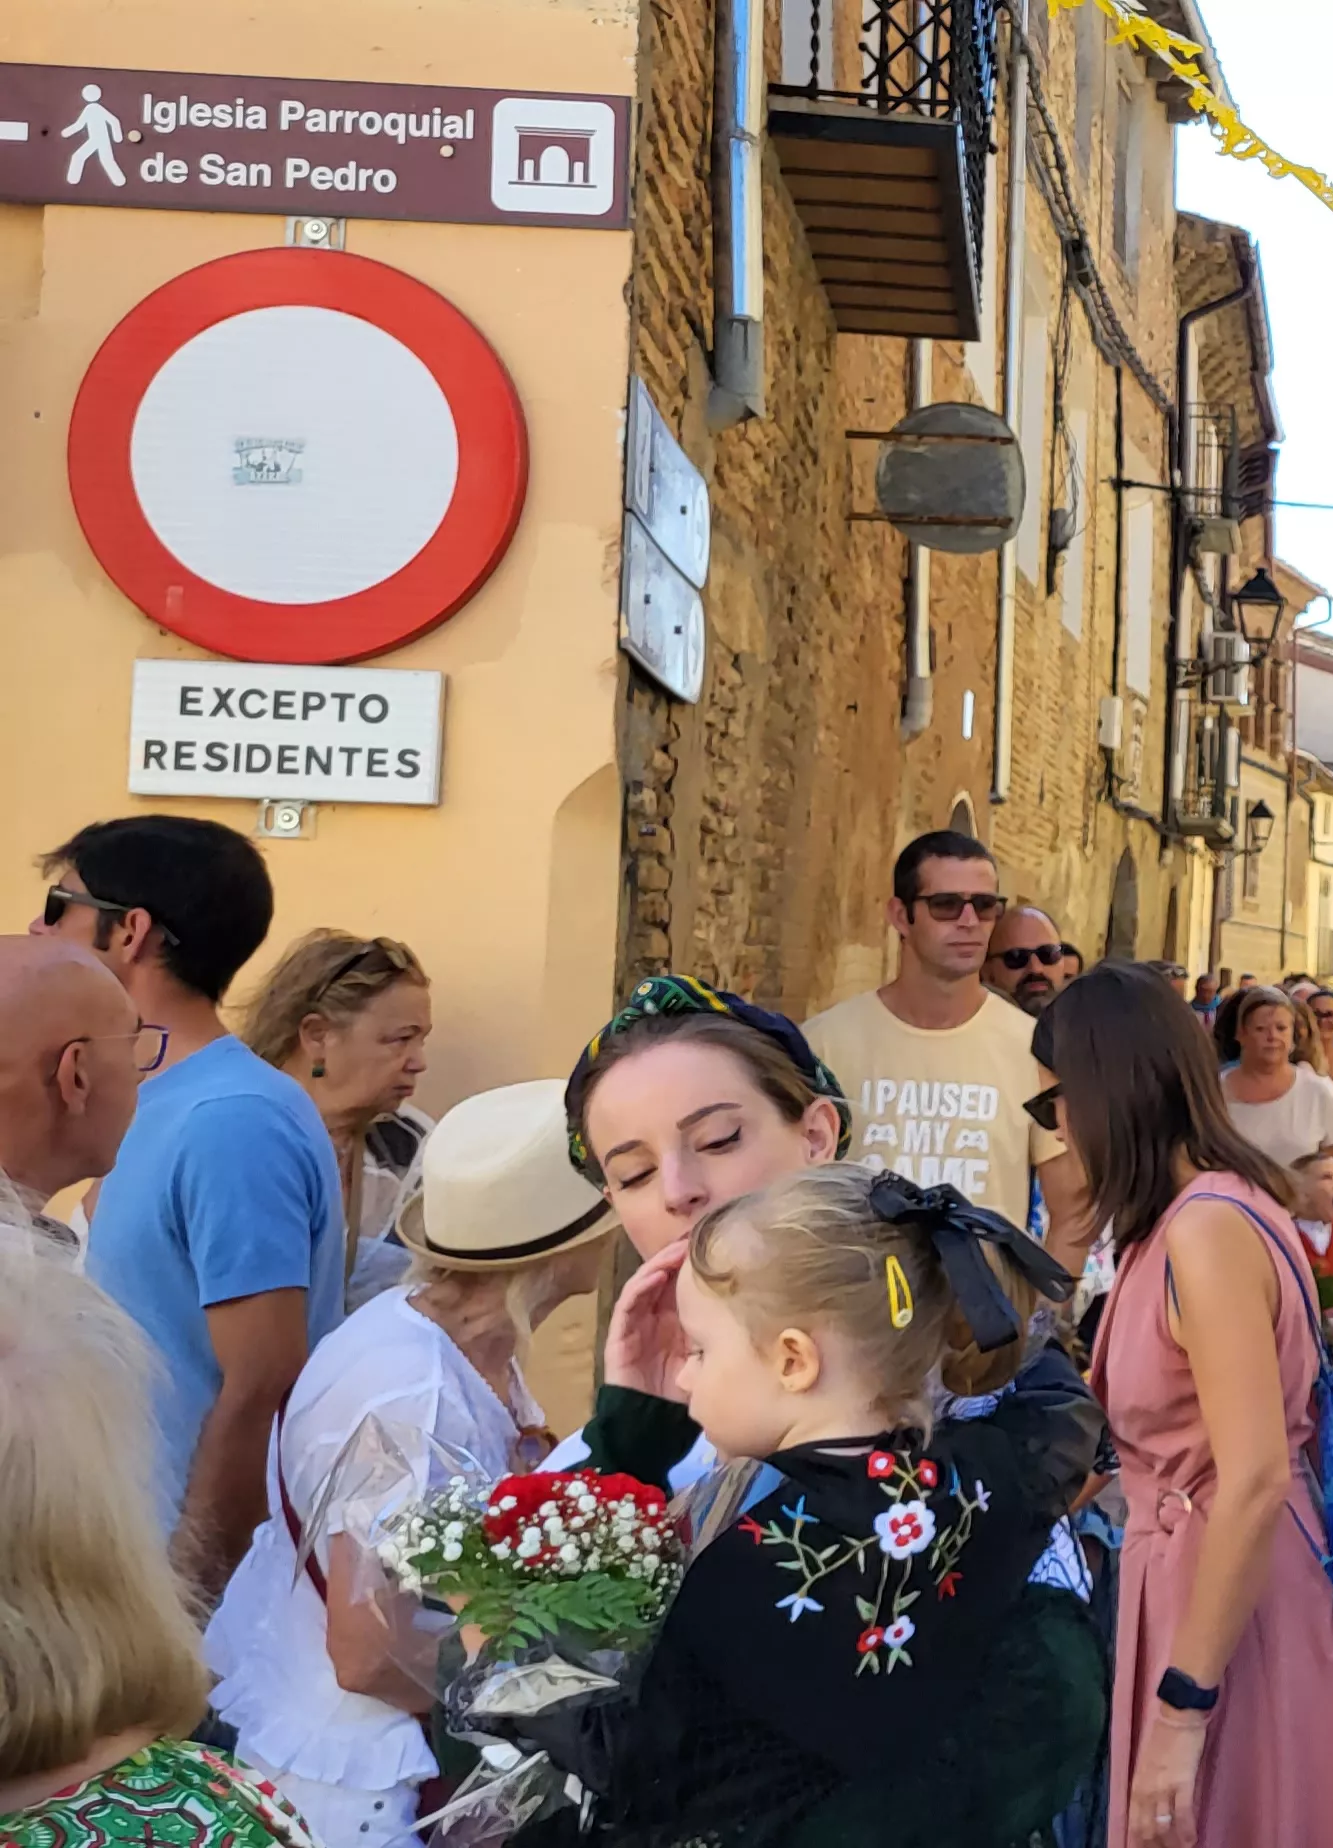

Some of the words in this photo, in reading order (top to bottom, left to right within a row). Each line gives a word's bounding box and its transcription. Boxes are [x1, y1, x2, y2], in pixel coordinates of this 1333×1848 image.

[142, 93, 267, 134] Iglesia
[280, 99, 475, 144] Parroquial
[140, 151, 188, 184] de
[199, 153, 272, 188] San
[285, 157, 398, 193] Pedro
[179, 685, 389, 724] EXCEPTO
[143, 739, 421, 779] RESIDENTES
[861, 1079, 871, 1116] I
[876, 1079, 999, 1121] PAUSED
[903, 1119, 951, 1155] MY
